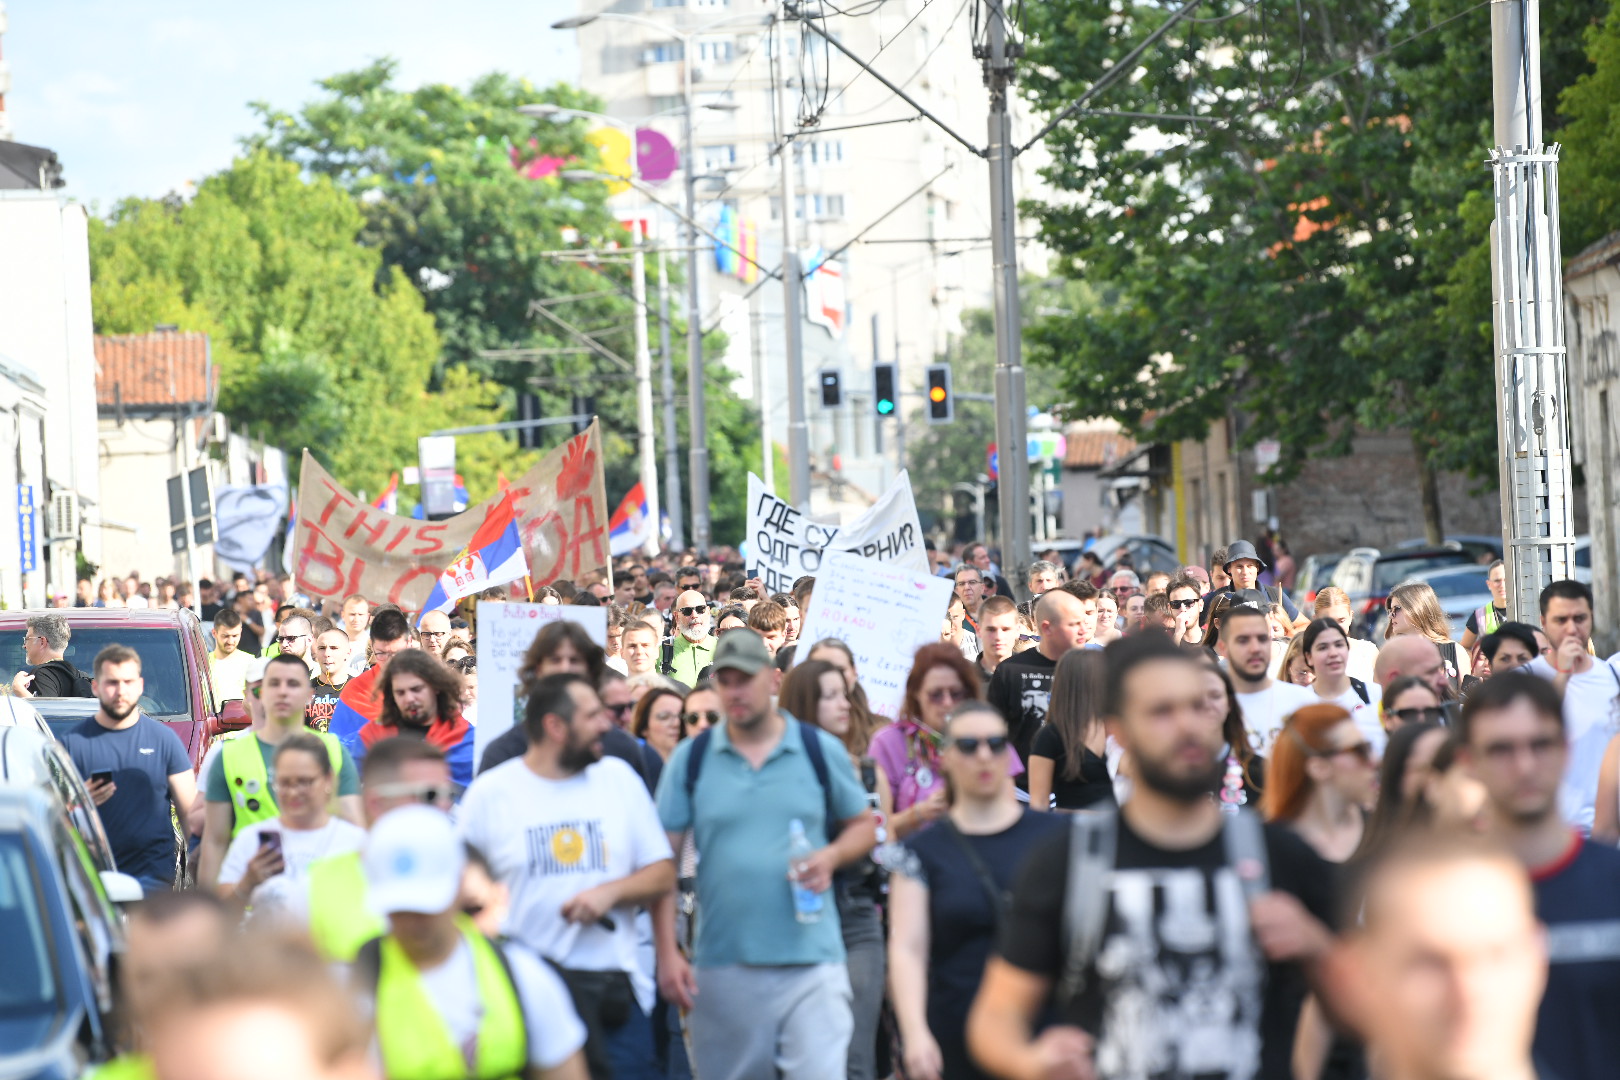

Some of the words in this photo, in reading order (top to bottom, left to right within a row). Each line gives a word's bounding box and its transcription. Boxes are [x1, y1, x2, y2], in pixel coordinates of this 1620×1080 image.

[321, 478, 449, 555] THIS
[757, 493, 801, 536] ГДЕ
[805, 524, 839, 549] СУ
[820, 607, 876, 631] ROKADU
